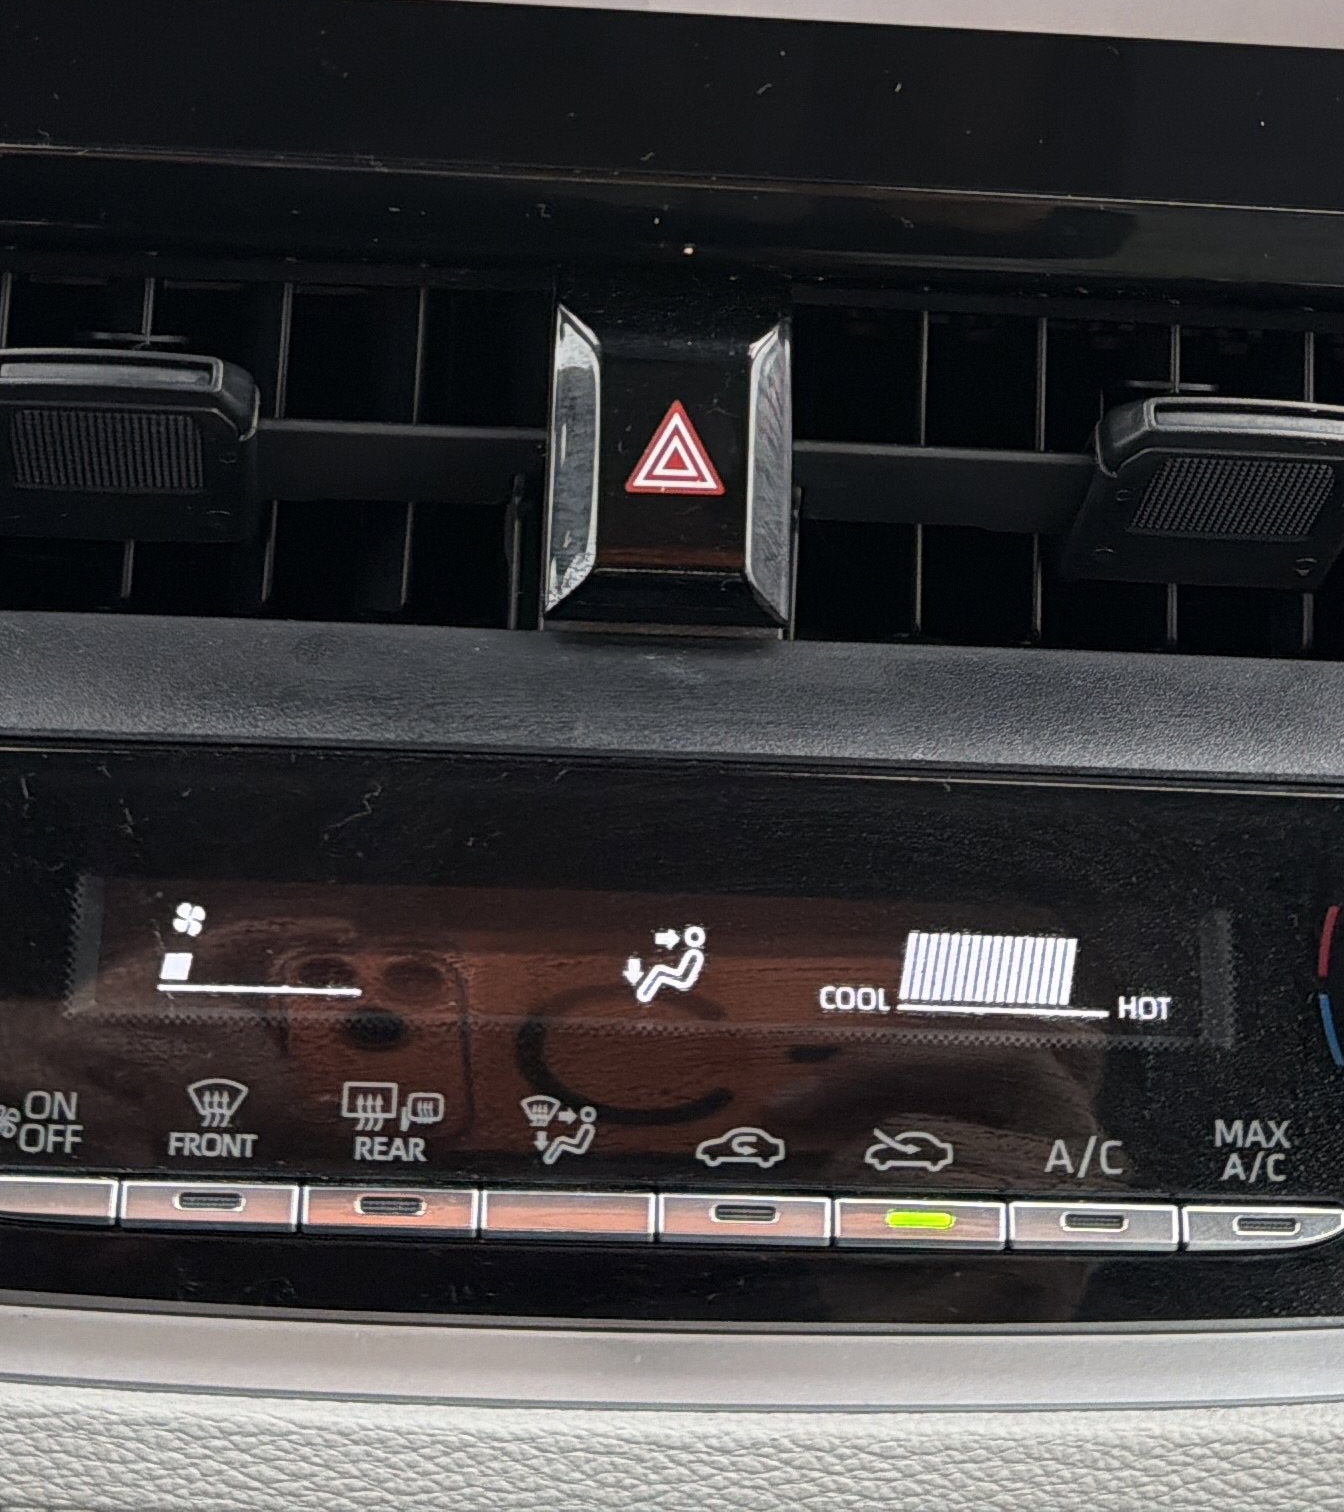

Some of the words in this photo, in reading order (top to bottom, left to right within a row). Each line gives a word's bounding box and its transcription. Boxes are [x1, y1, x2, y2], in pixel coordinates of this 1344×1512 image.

[819, 985, 891, 1012] COOL
[1118, 995, 1172, 1021] HOT
[24, 1090, 78, 1121] ON
[18, 1123, 84, 1154] OFF
[168, 1131, 259, 1158] FRONT
[354, 1136, 427, 1162] REAR
[1214, 1118, 1291, 1149] MAX
[1044, 1135, 1123, 1179] A/C
[1220, 1150, 1287, 1184] A/C
